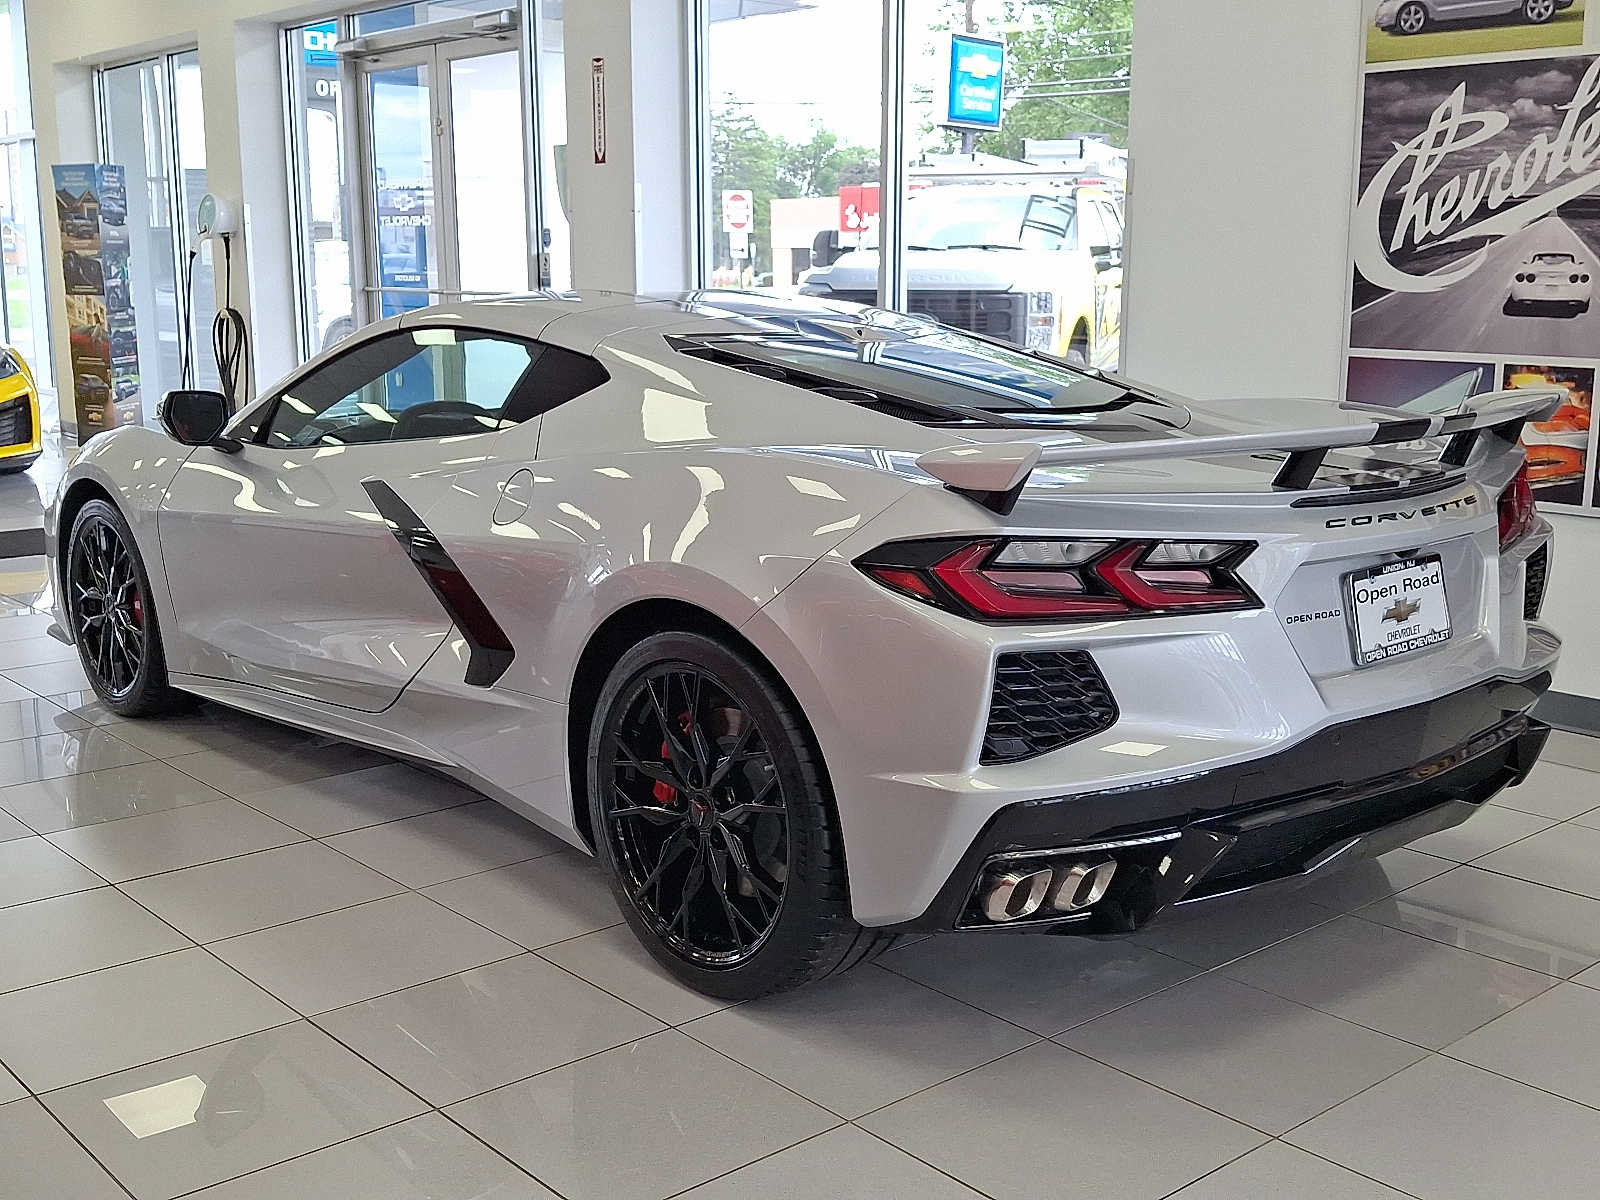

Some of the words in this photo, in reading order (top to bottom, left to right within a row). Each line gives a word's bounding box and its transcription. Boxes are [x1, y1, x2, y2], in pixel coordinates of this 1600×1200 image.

[1325, 495, 1478, 529] CORVETTE
[1406, 560, 1416, 569] NJ
[1356, 584, 1398, 605] Open
[1402, 571, 1440, 592] Road
[1286, 613, 1313, 624] OPEN
[1314, 609, 1341, 621] ROAD
[1387, 624, 1421, 642] CHEVROLET
[1366, 649, 1387, 662] OPEN
[1387, 643, 1409, 656] ROAD
[1408, 630, 1450, 649] CHEVROLET
